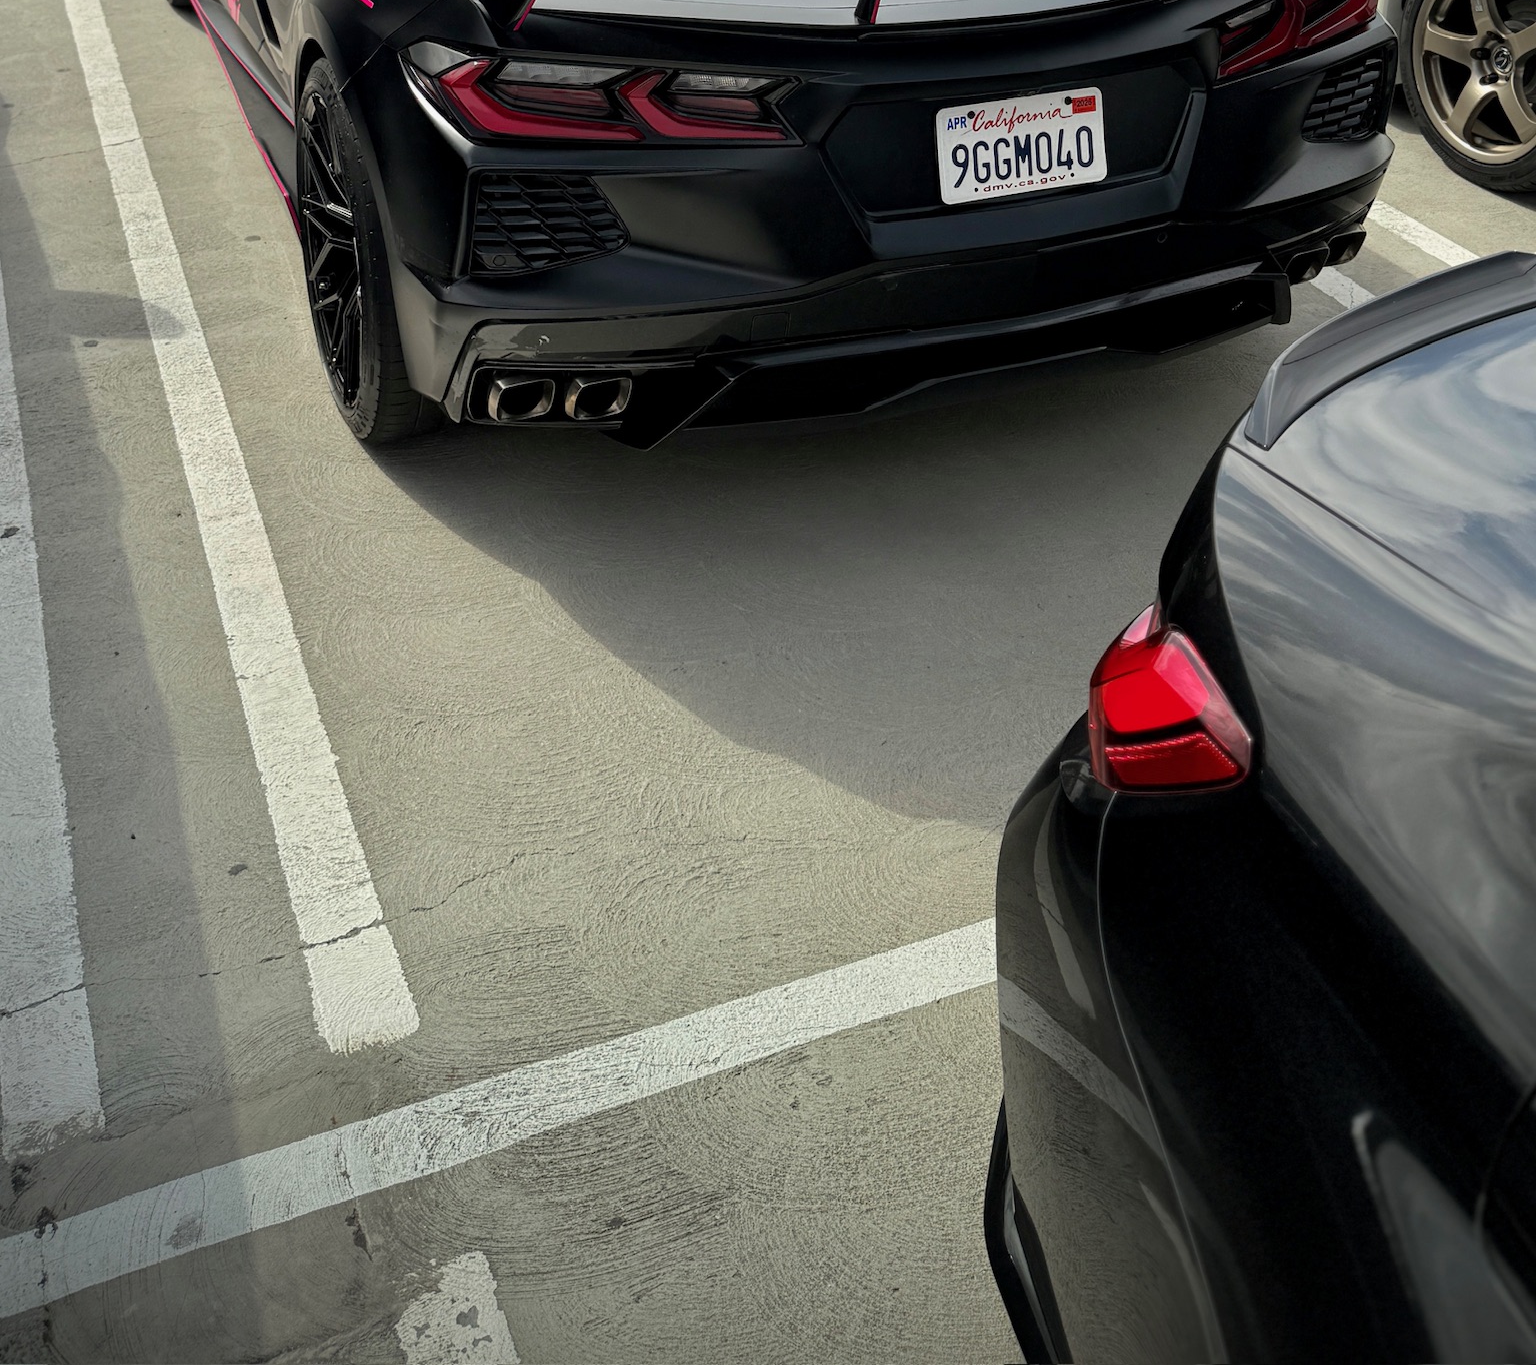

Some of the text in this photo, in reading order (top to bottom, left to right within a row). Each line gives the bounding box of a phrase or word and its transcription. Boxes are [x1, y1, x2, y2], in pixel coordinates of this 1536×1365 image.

[947, 116, 967, 131] APR
[972, 103, 1072, 133] California
[951, 125, 1094, 188] 9GGM040
[983, 174, 1066, 193] dmv.ca.gov
